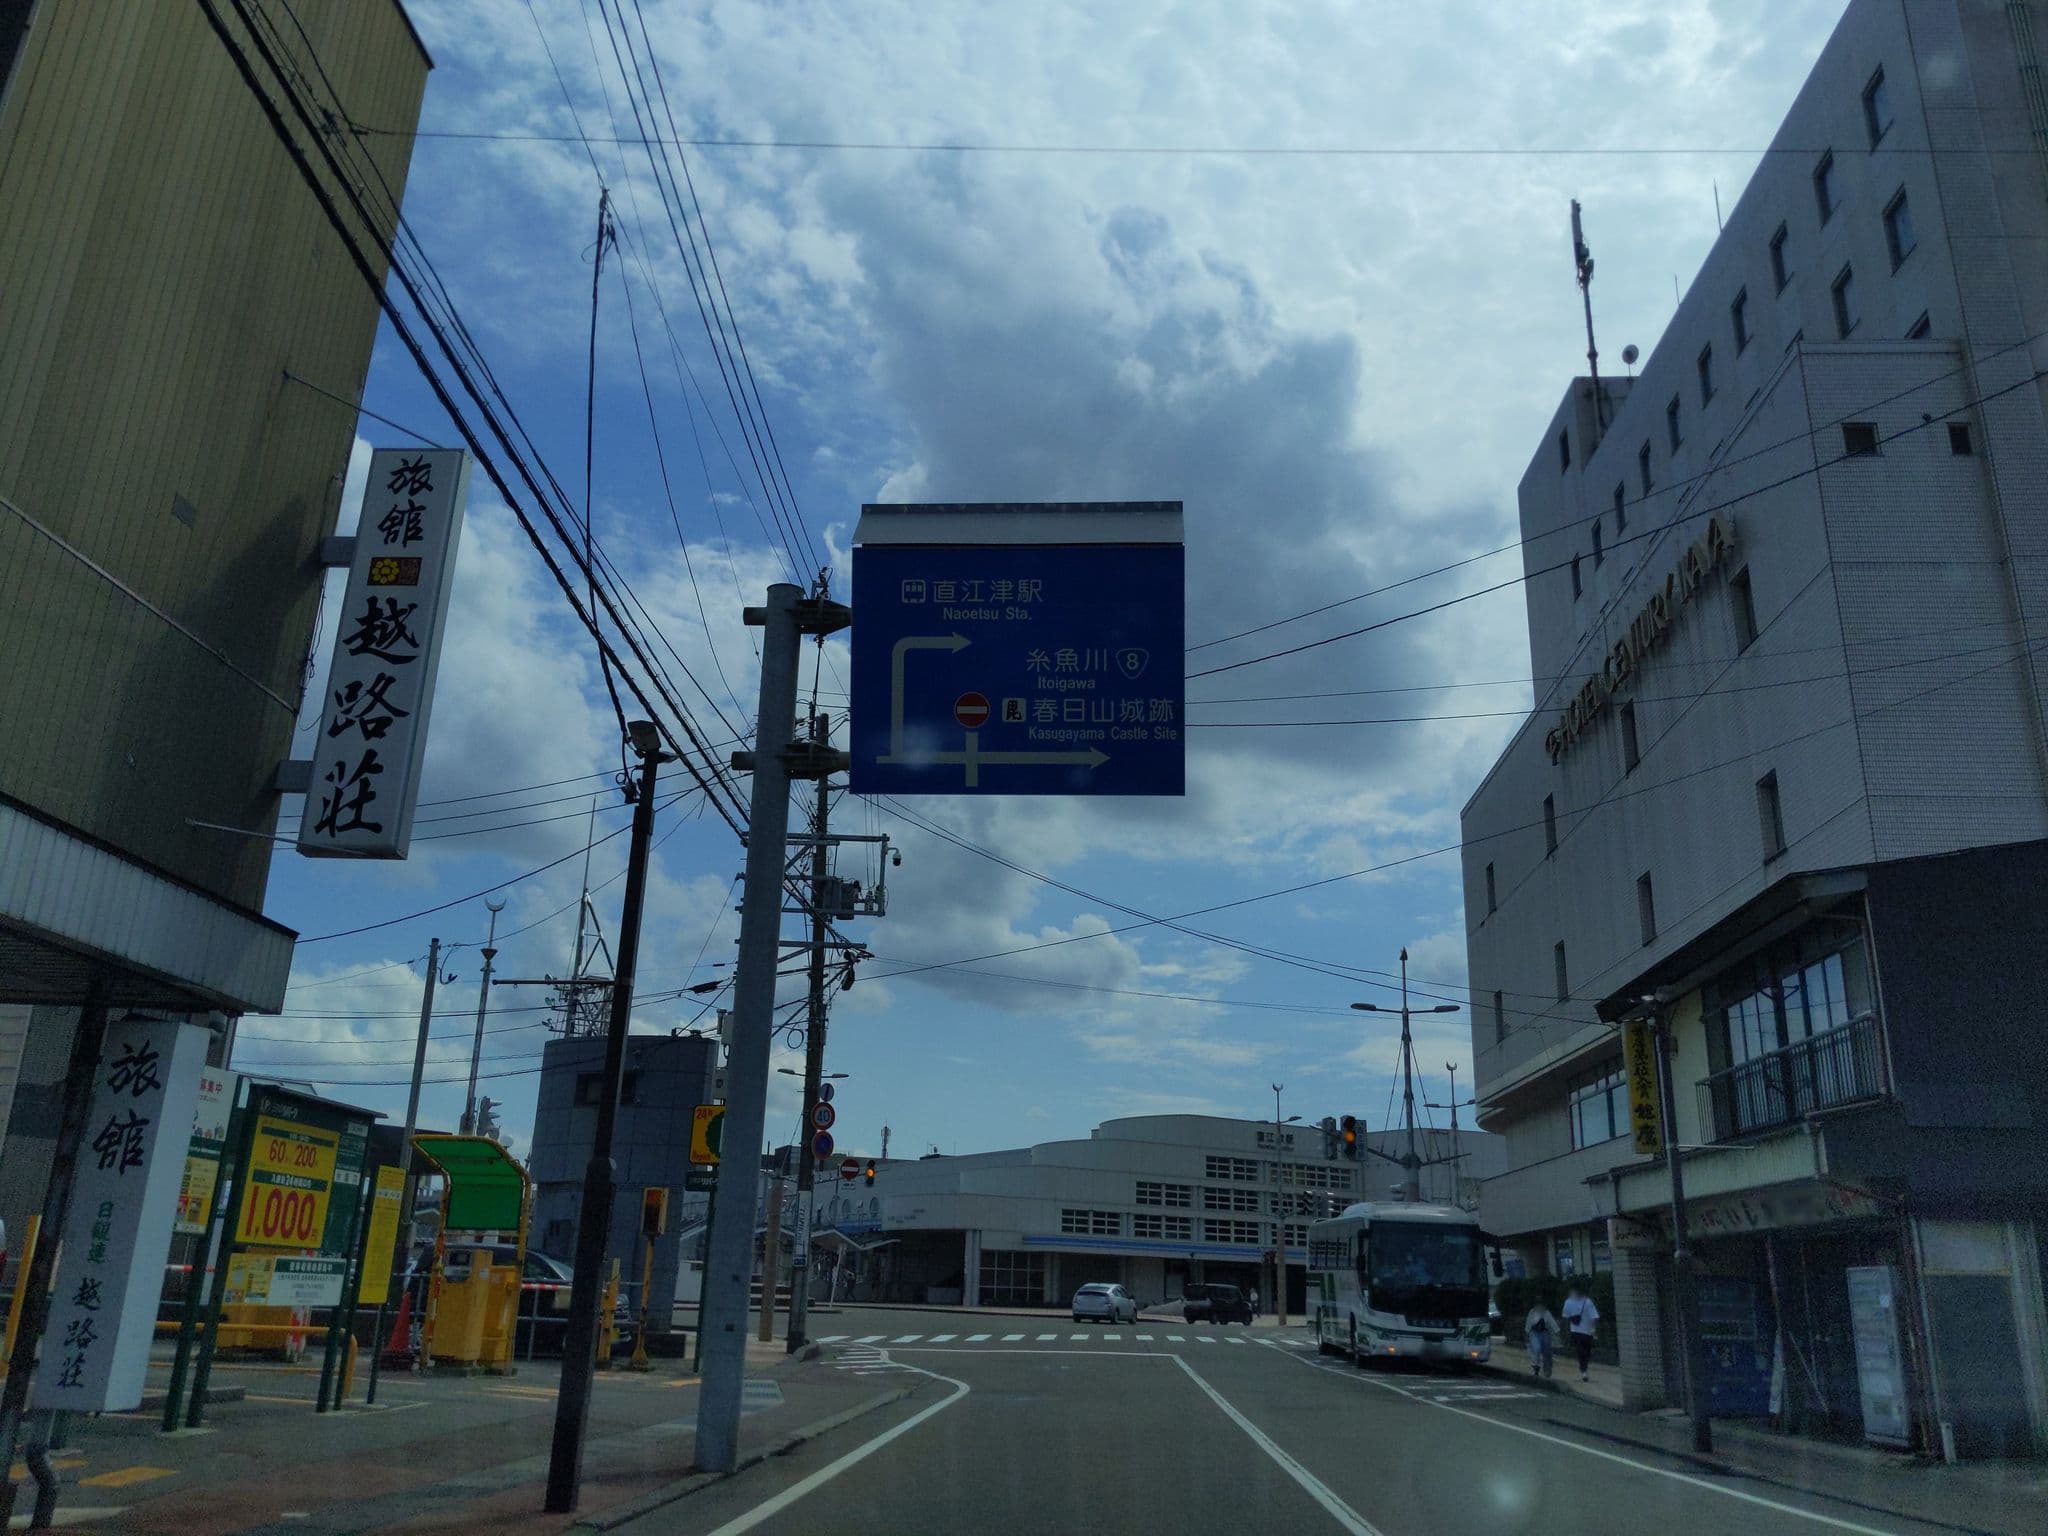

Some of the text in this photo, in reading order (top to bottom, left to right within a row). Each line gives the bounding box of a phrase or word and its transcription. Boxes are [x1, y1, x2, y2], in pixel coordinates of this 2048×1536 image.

[932, 579, 1044, 604] 直江津駅
[943, 607, 1033, 620] Naoetsu Sta.
[314, 454, 433, 839] 旅館 越路荘
[1025, 648, 1139, 673] 糸魚川 8
[1037, 677, 1096, 692] Itoigawa
[1032, 698, 1175, 723] 春日山城跡
[1028, 727, 1177, 743] Kasugayama Castle Site
[91, 1039, 163, 1175] 旅館
[817, 1110, 830, 1123] 40
[294, 1144, 317, 1168] 200
[57, 1277, 103, 1390] 越路荘
